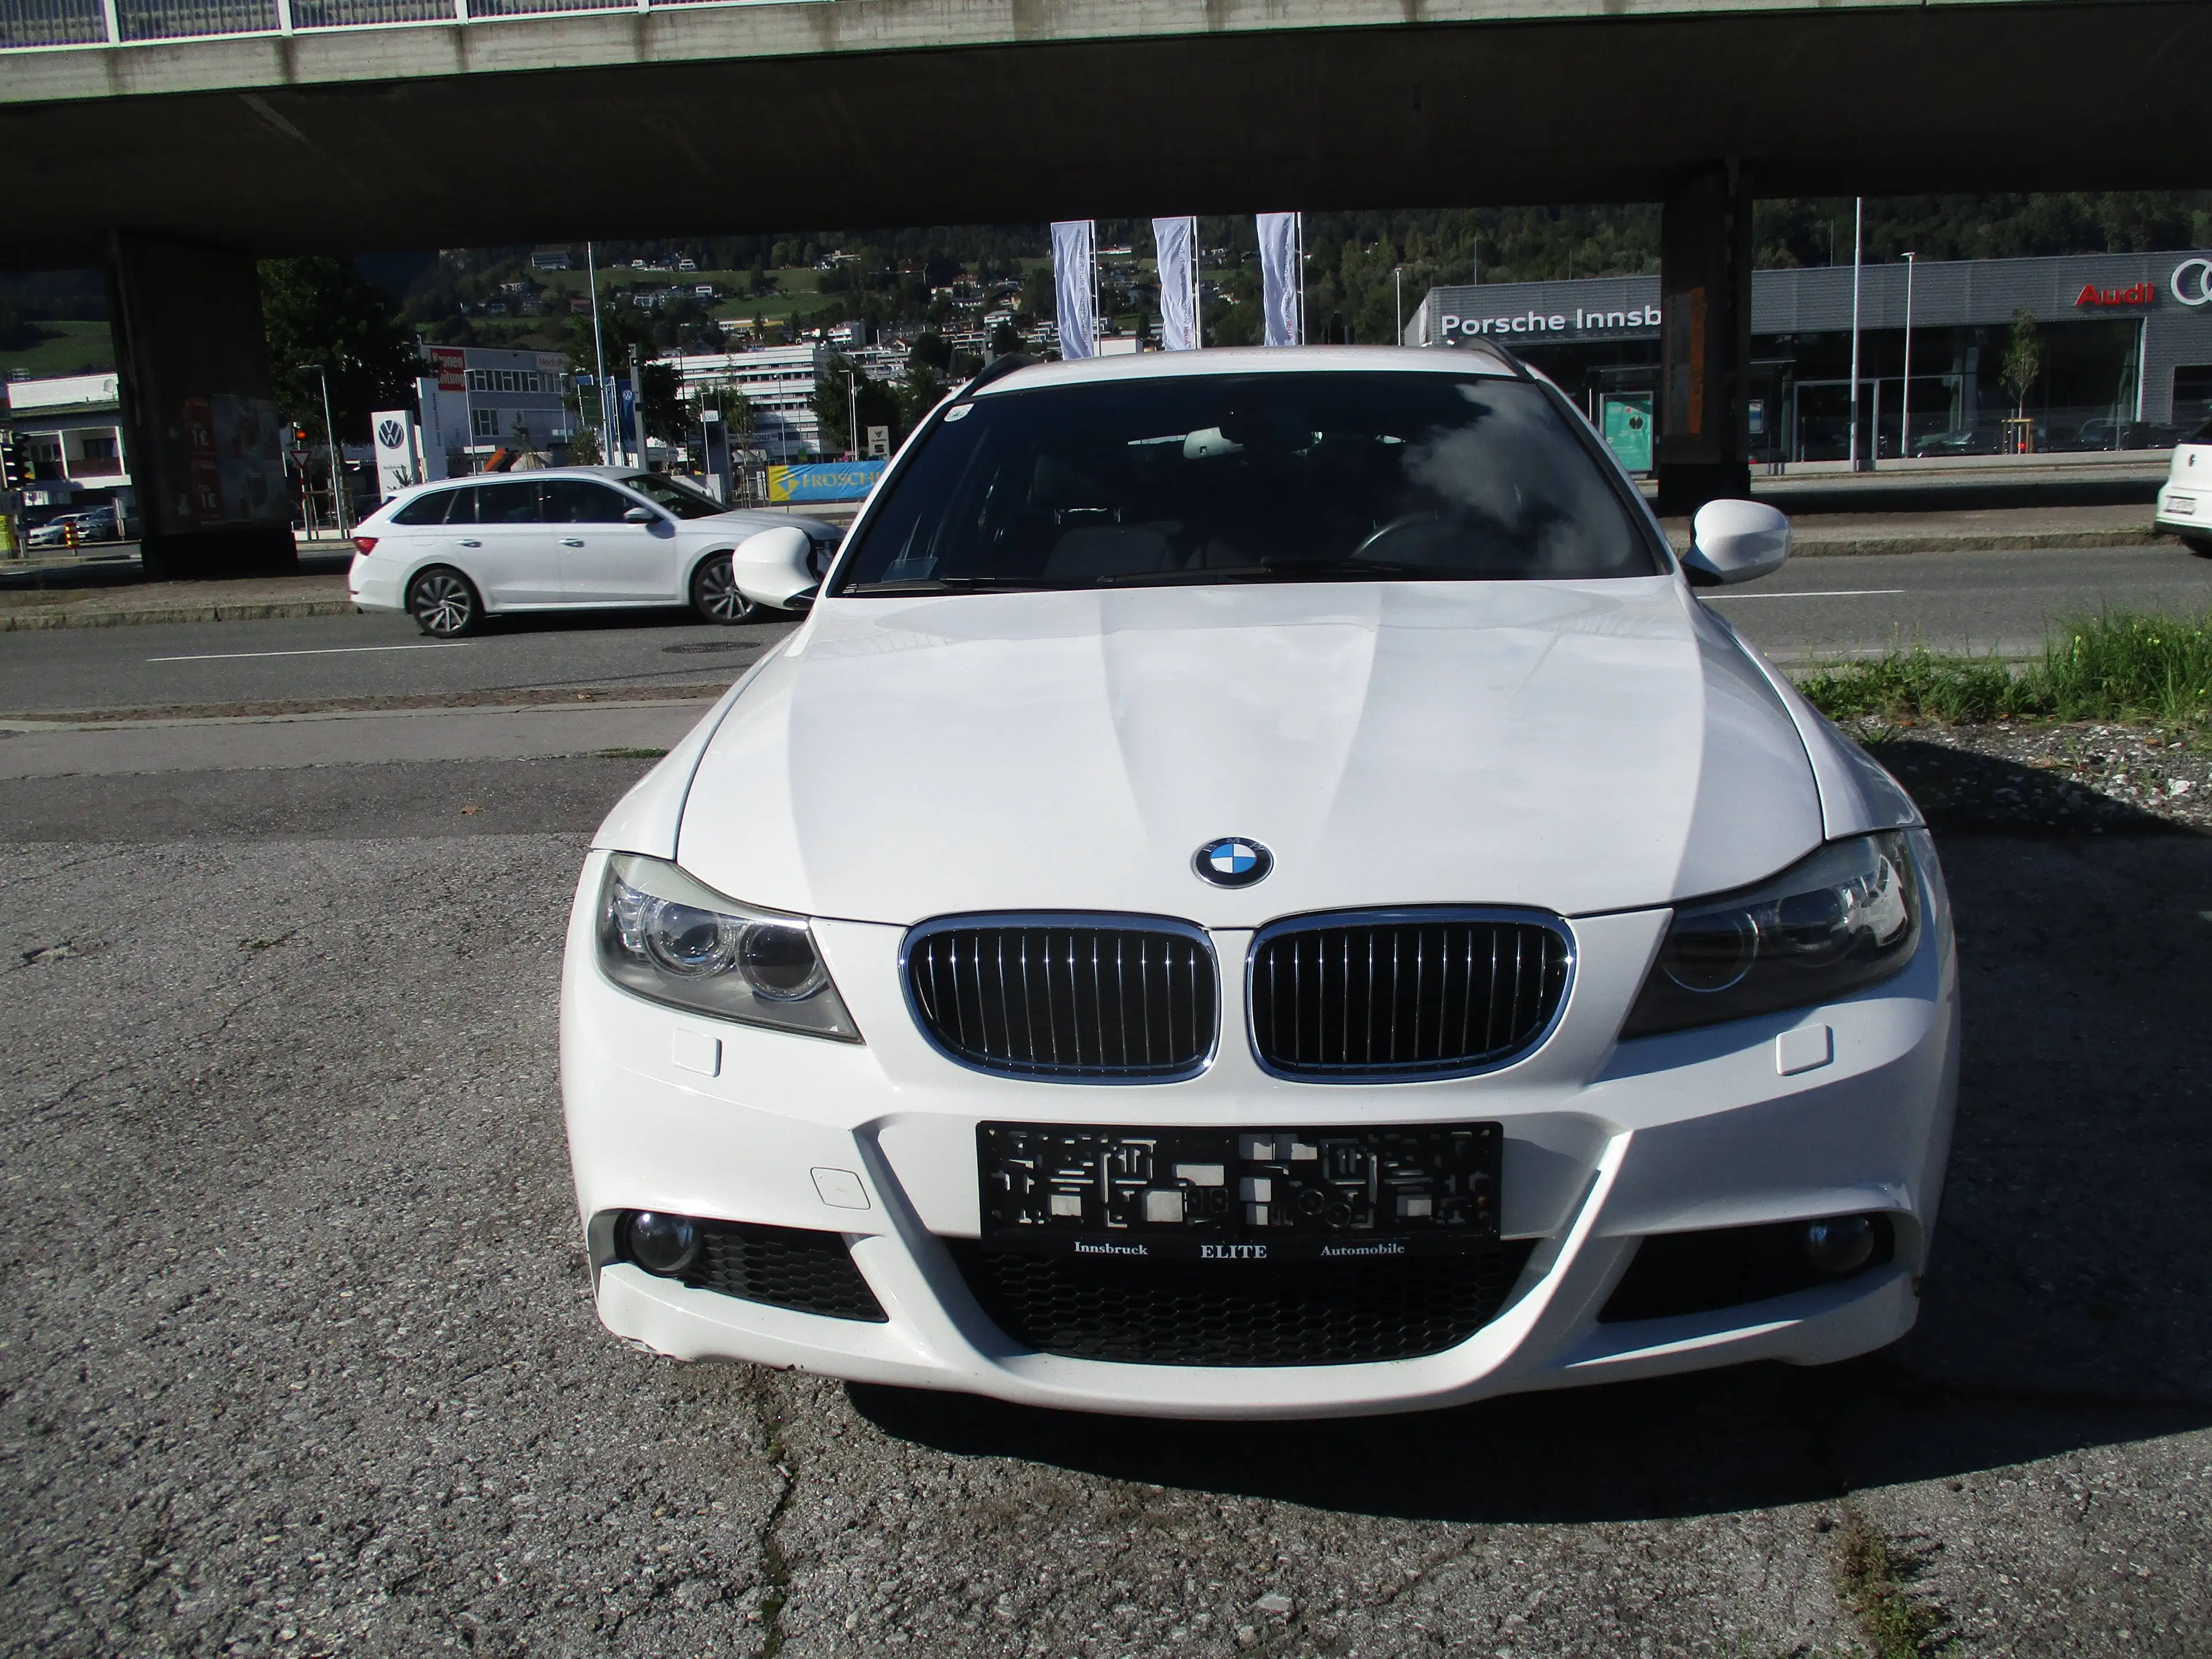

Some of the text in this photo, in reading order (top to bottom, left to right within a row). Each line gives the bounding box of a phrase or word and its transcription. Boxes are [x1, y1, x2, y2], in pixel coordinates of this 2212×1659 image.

[2074, 282, 2154, 306] Audi
[1441, 305, 1662, 336] Porsche Innsb
[439, 369, 465, 387] eitung
[379, 420, 404, 449] VW
[1074, 1241, 1406, 1258] Innsbruck ELITE Automobile
